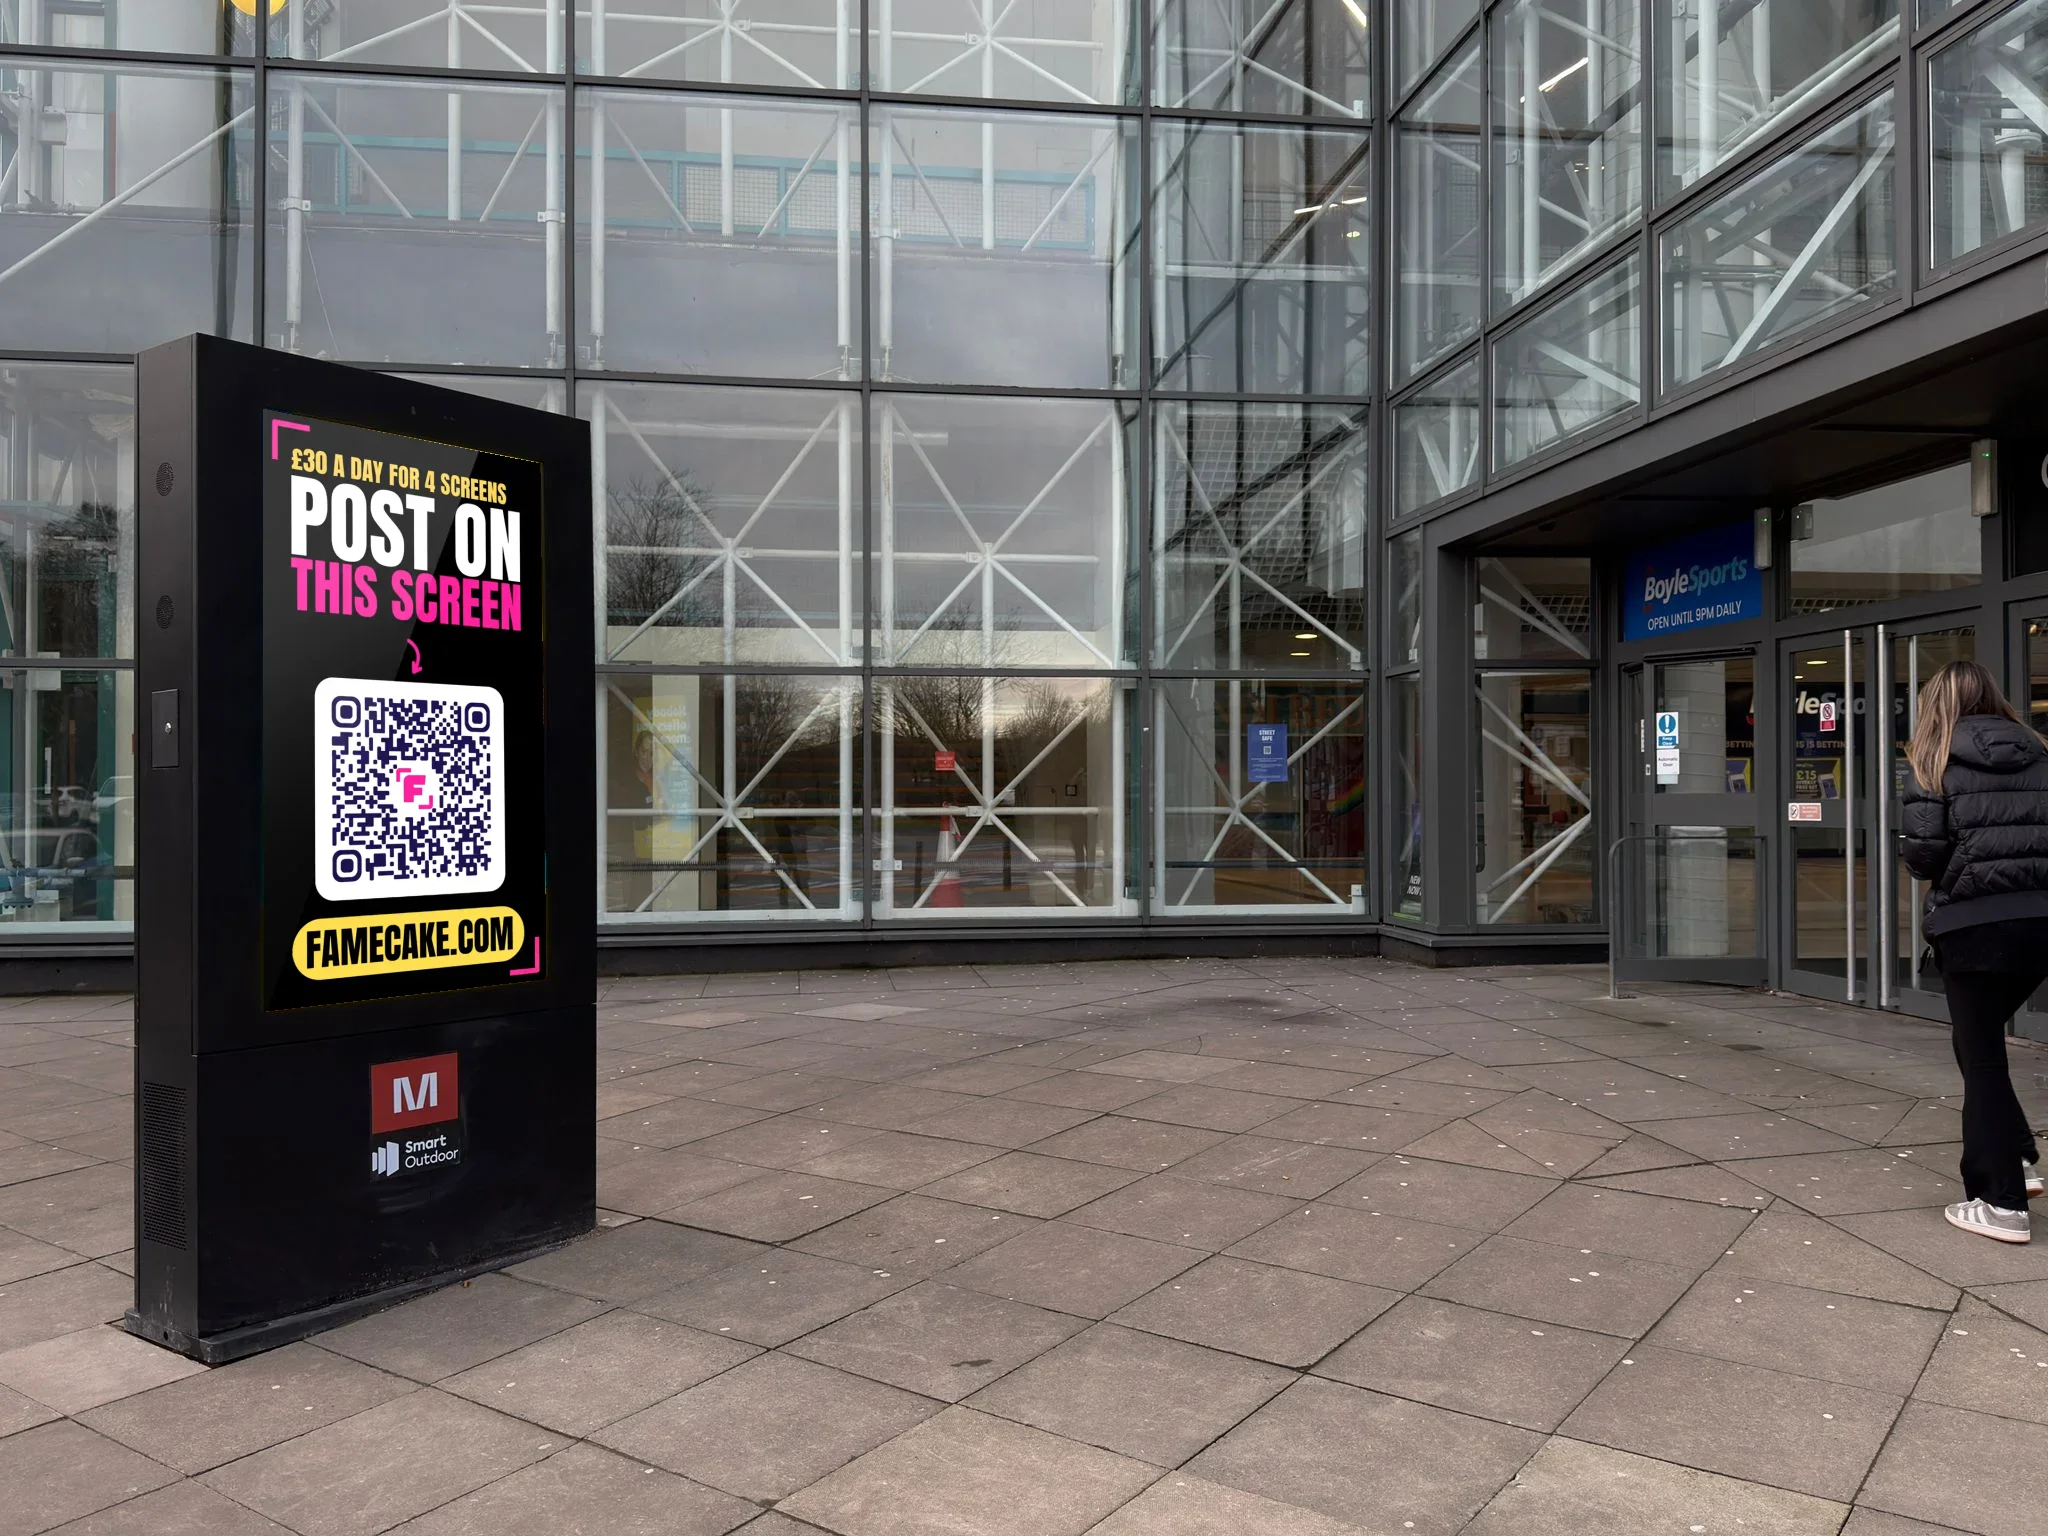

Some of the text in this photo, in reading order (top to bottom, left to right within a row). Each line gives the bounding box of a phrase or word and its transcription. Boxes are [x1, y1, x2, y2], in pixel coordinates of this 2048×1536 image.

[291, 448, 507, 505] £30 A DAY FOR 4 SCREENS
[290, 474, 521, 583] POST ON
[290, 556, 522, 632] THIS SCREEN
[1644, 556, 1748, 604] BoyleSports
[1647, 600, 1742, 631] OPEN UNTIL 9PM DAILY
[305, 915, 515, 969] FAMECAKE.COM
[393, 1072, 438, 1114] M
[405, 1134, 447, 1153] Smart
[405, 1149, 459, 1169] Outdoor
